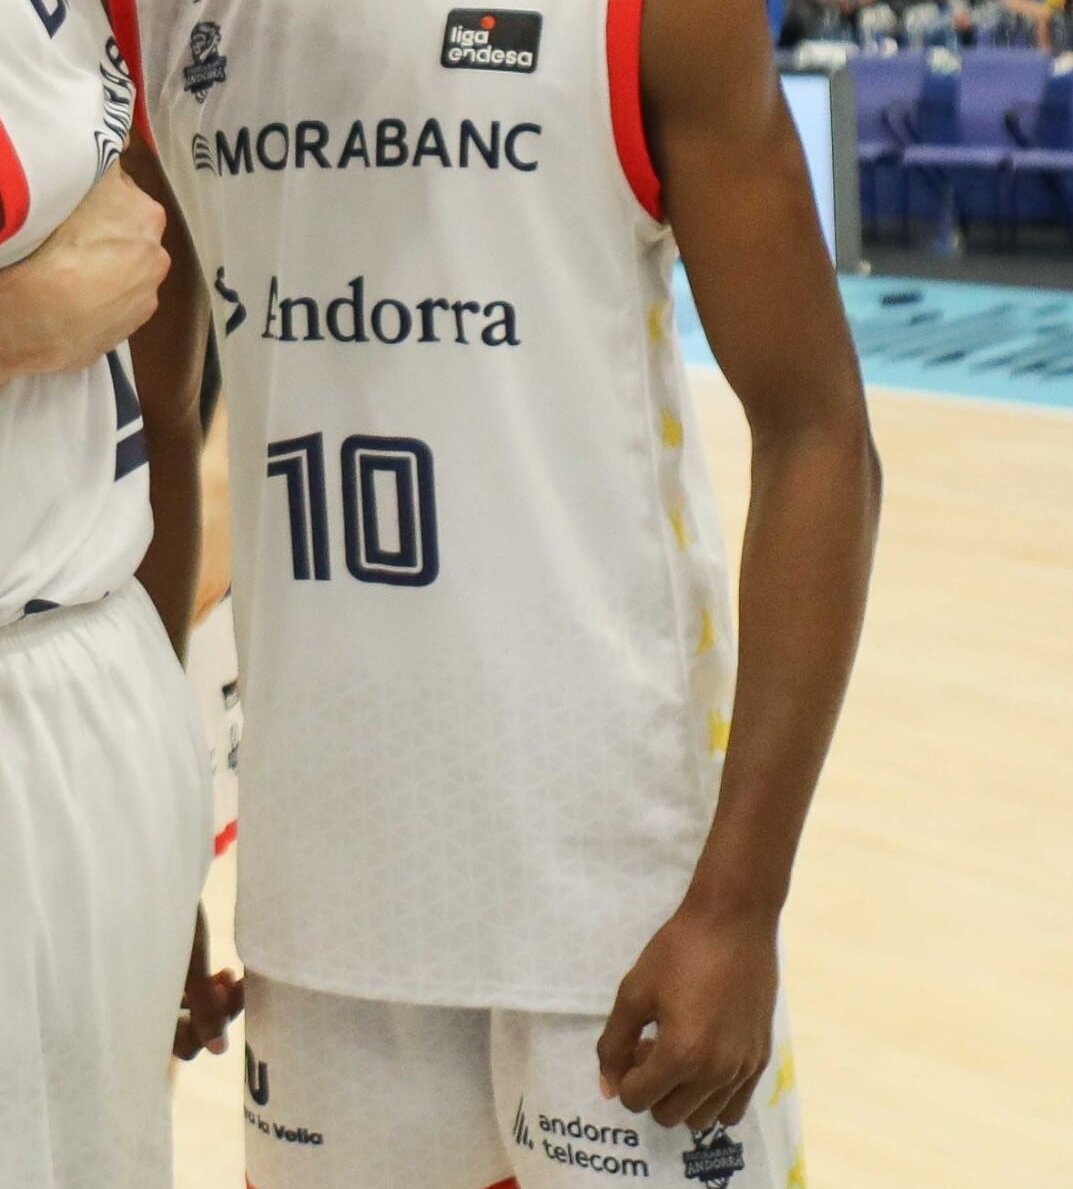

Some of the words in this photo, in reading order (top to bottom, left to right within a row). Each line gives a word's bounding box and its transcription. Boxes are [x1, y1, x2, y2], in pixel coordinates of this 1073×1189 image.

[451, 25, 489, 46] liga
[449, 45, 533, 67] endesa
[216, 118, 542, 177] MORABANC
[267, 431, 439, 587] 10
[539, 1114, 640, 1147] andorra
[543, 1139, 649, 1177] telecom
